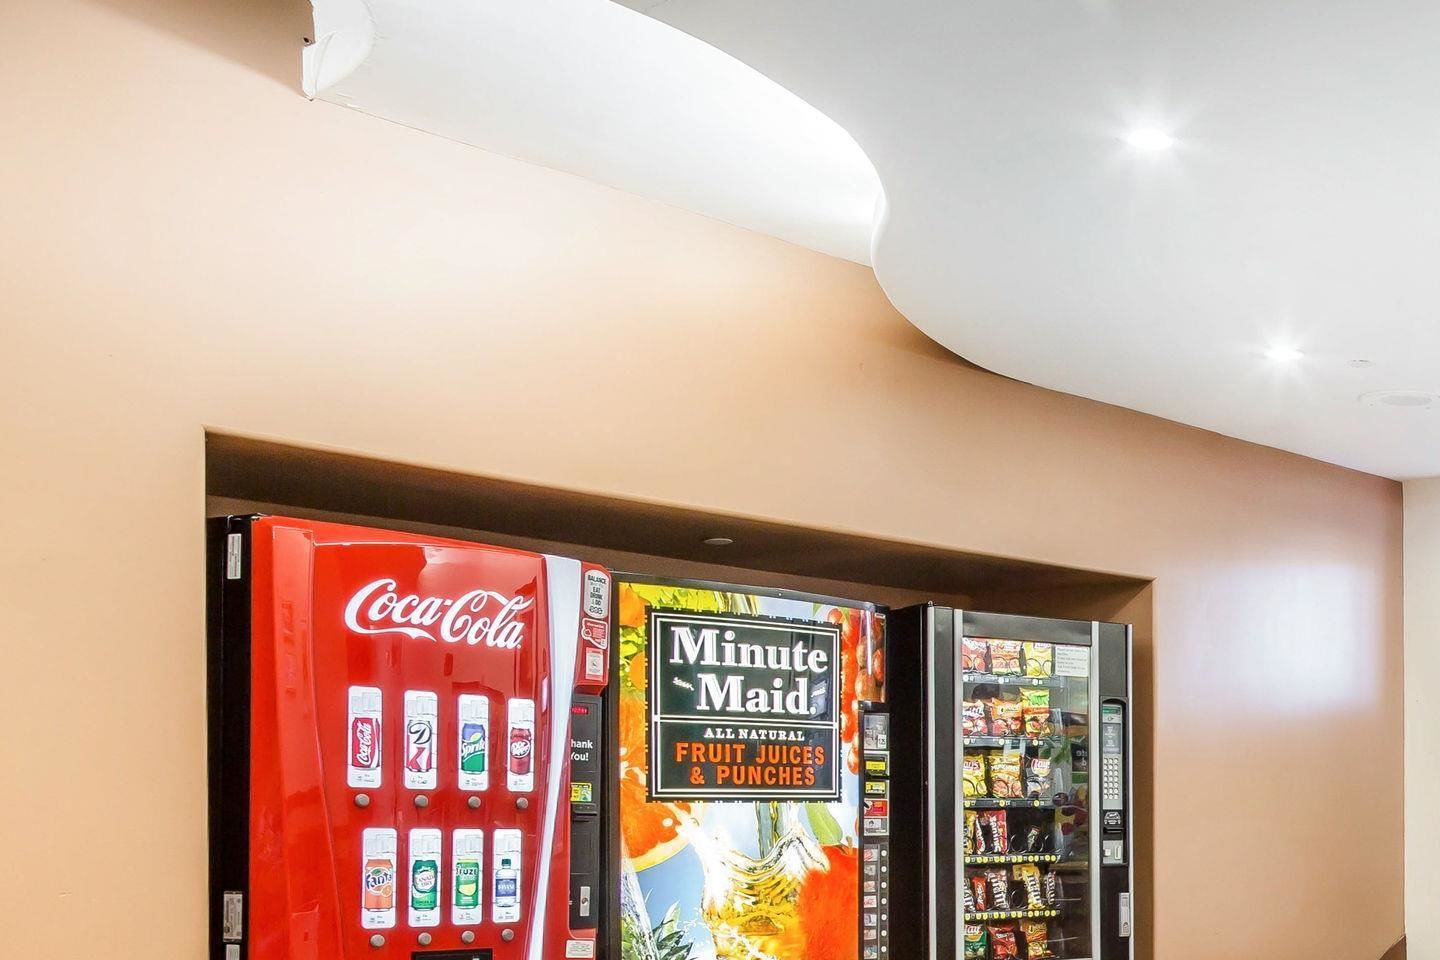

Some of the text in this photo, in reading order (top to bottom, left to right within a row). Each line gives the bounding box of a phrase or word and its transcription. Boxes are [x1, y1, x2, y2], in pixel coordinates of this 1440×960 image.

[344, 578, 535, 650] Coca-Cola
[669, 626, 828, 673] Minute
[571, 739, 593, 749] hank
[704, 728, 805, 741] ALL NATURAL
[675, 742, 825, 765] FRUIT JUICES
[690, 766, 816, 785] & PUNCHES
